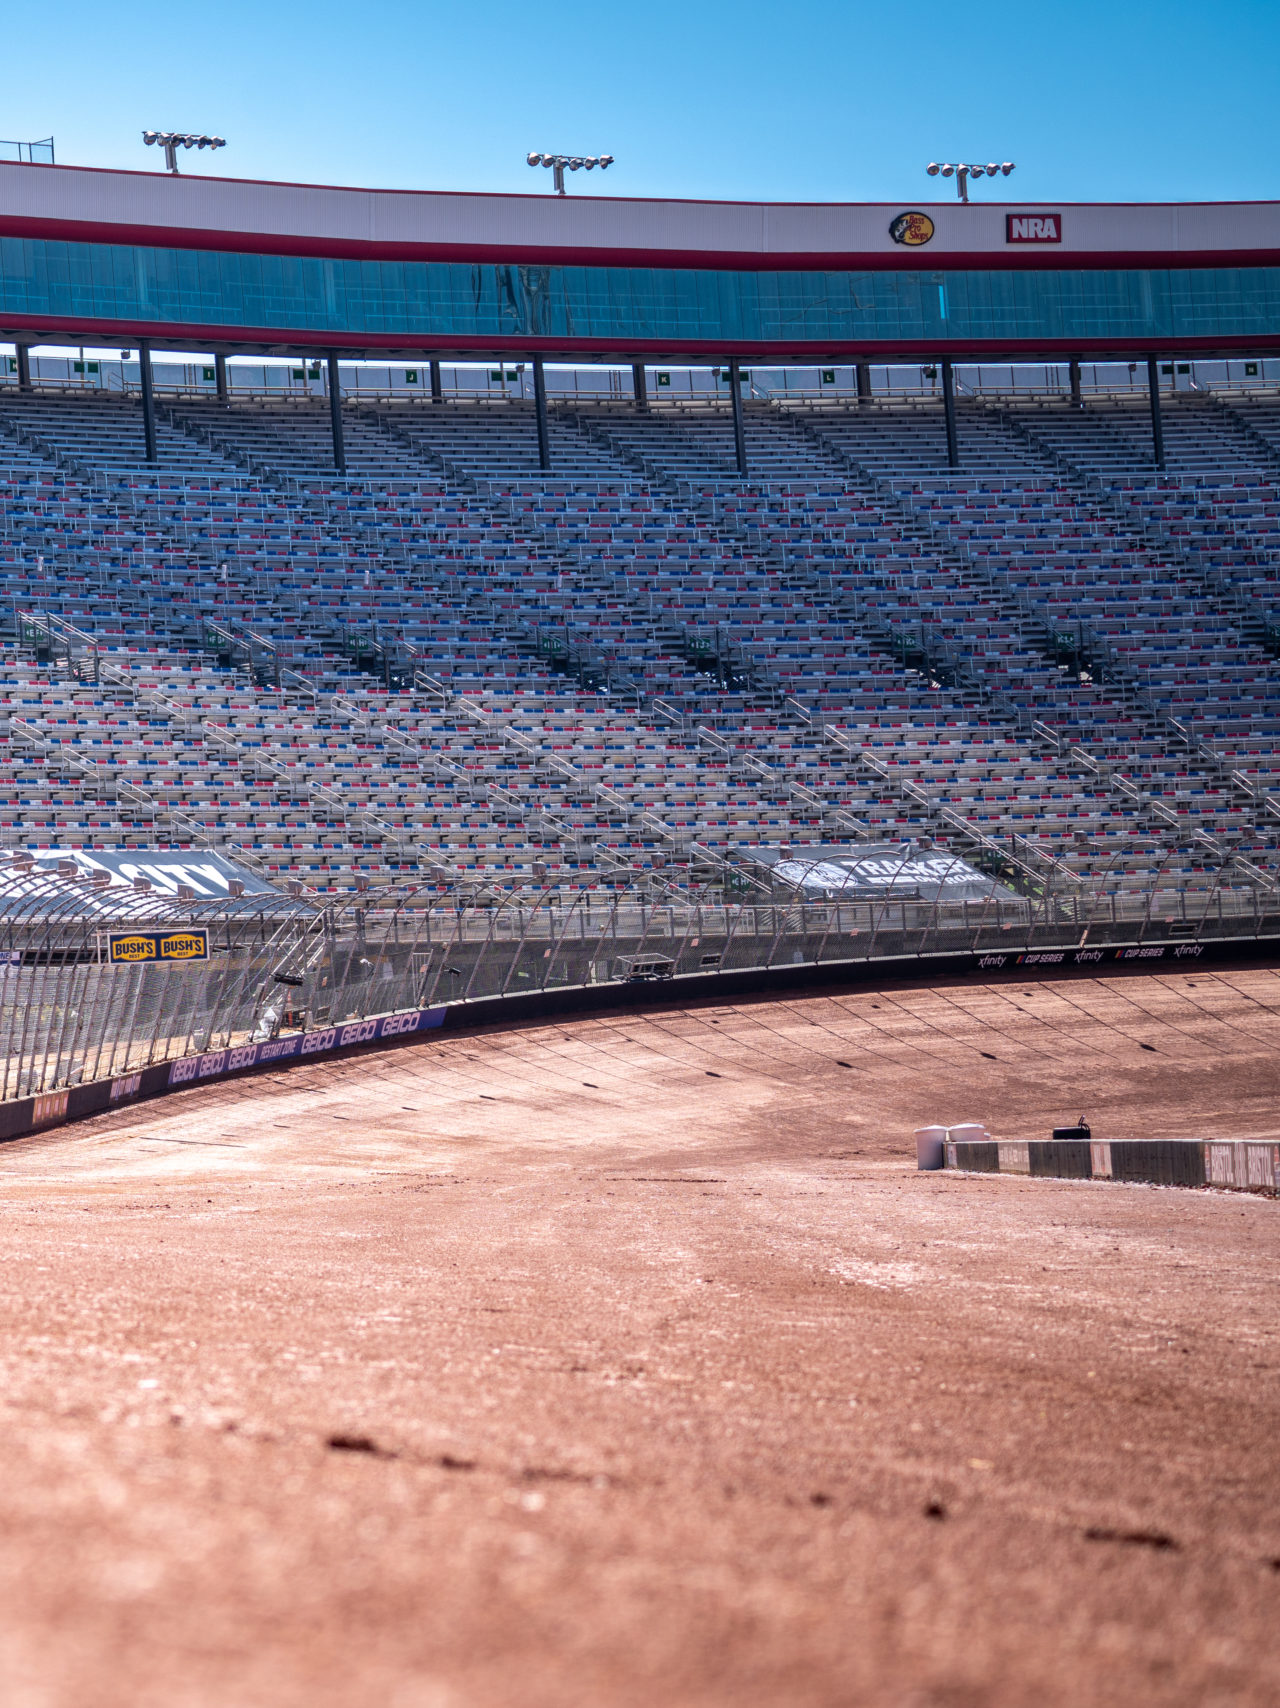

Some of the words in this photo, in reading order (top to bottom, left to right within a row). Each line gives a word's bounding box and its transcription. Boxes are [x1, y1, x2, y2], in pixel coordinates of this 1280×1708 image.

[909, 215, 925, 224] Bass
[909, 224, 921, 232] Pro
[909, 231, 929, 241] Shops
[1012, 218, 1057, 239] NRA
[840, 858, 974, 876] TRACKER
[118, 863, 232, 896] CITY
[944, 873, 987, 885] ROAD
[115, 942, 154, 956] BUSH'S
[163, 939, 202, 954] BUSH'S
[978, 954, 1007, 968] xfinity
[1025, 954, 1040, 963] CUP
[1039, 953, 1064, 963] SERIES
[1074, 950, 1104, 963] xfinity
[1124, 949, 1140, 958] CUP
[1138, 948, 1165, 957] SERIES
[1173, 945, 1204, 958] xfinity
[173, 1058, 198, 1083] GEICO
[199, 1052, 226, 1077] GEICO
[228, 1044, 258, 1070] GEICO
[260, 1042, 285, 1060] RESTART
[301, 1029, 337, 1054] GEICO
[340, 1020, 377, 1046] GEICO
[381, 1012, 421, 1037] GEICO
